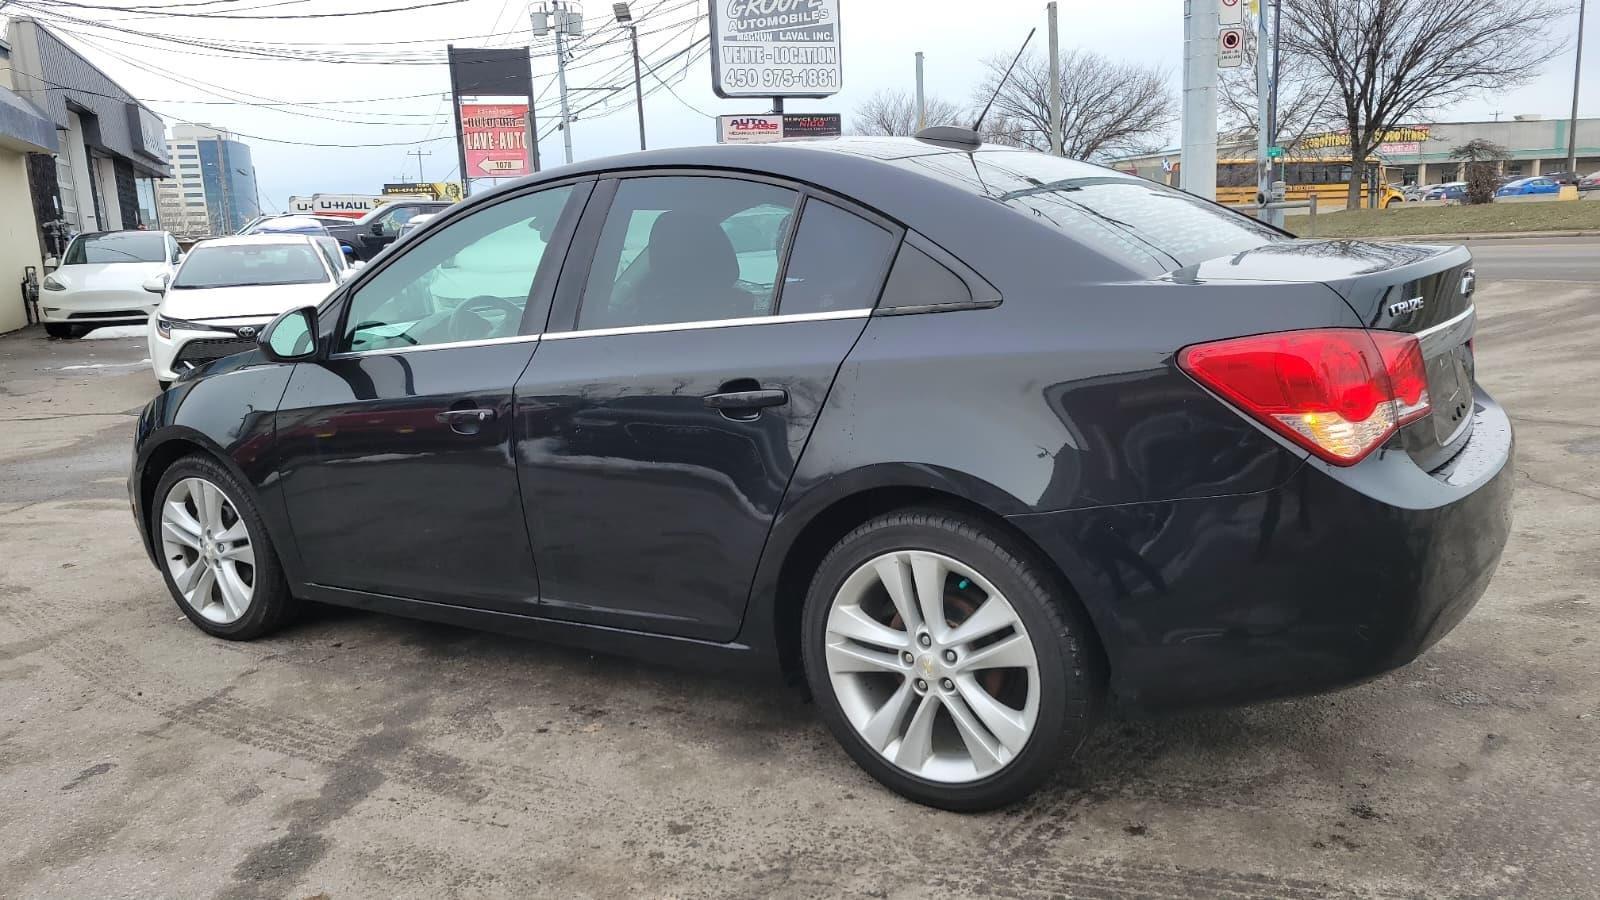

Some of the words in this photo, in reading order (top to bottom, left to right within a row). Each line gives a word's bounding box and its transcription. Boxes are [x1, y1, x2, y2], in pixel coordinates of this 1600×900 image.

[728, 9, 829, 32] AUTOMOBILES
[780, 31, 810, 41] LAVAL
[813, 31, 833, 41] INC.
[725, 68, 758, 87] 450
[763, 68, 836, 87] 975-1881
[730, 118, 768, 127] AUTO
[320, 201, 371, 210] U-HAUL
[1389, 296, 1424, 316] CRUZE
